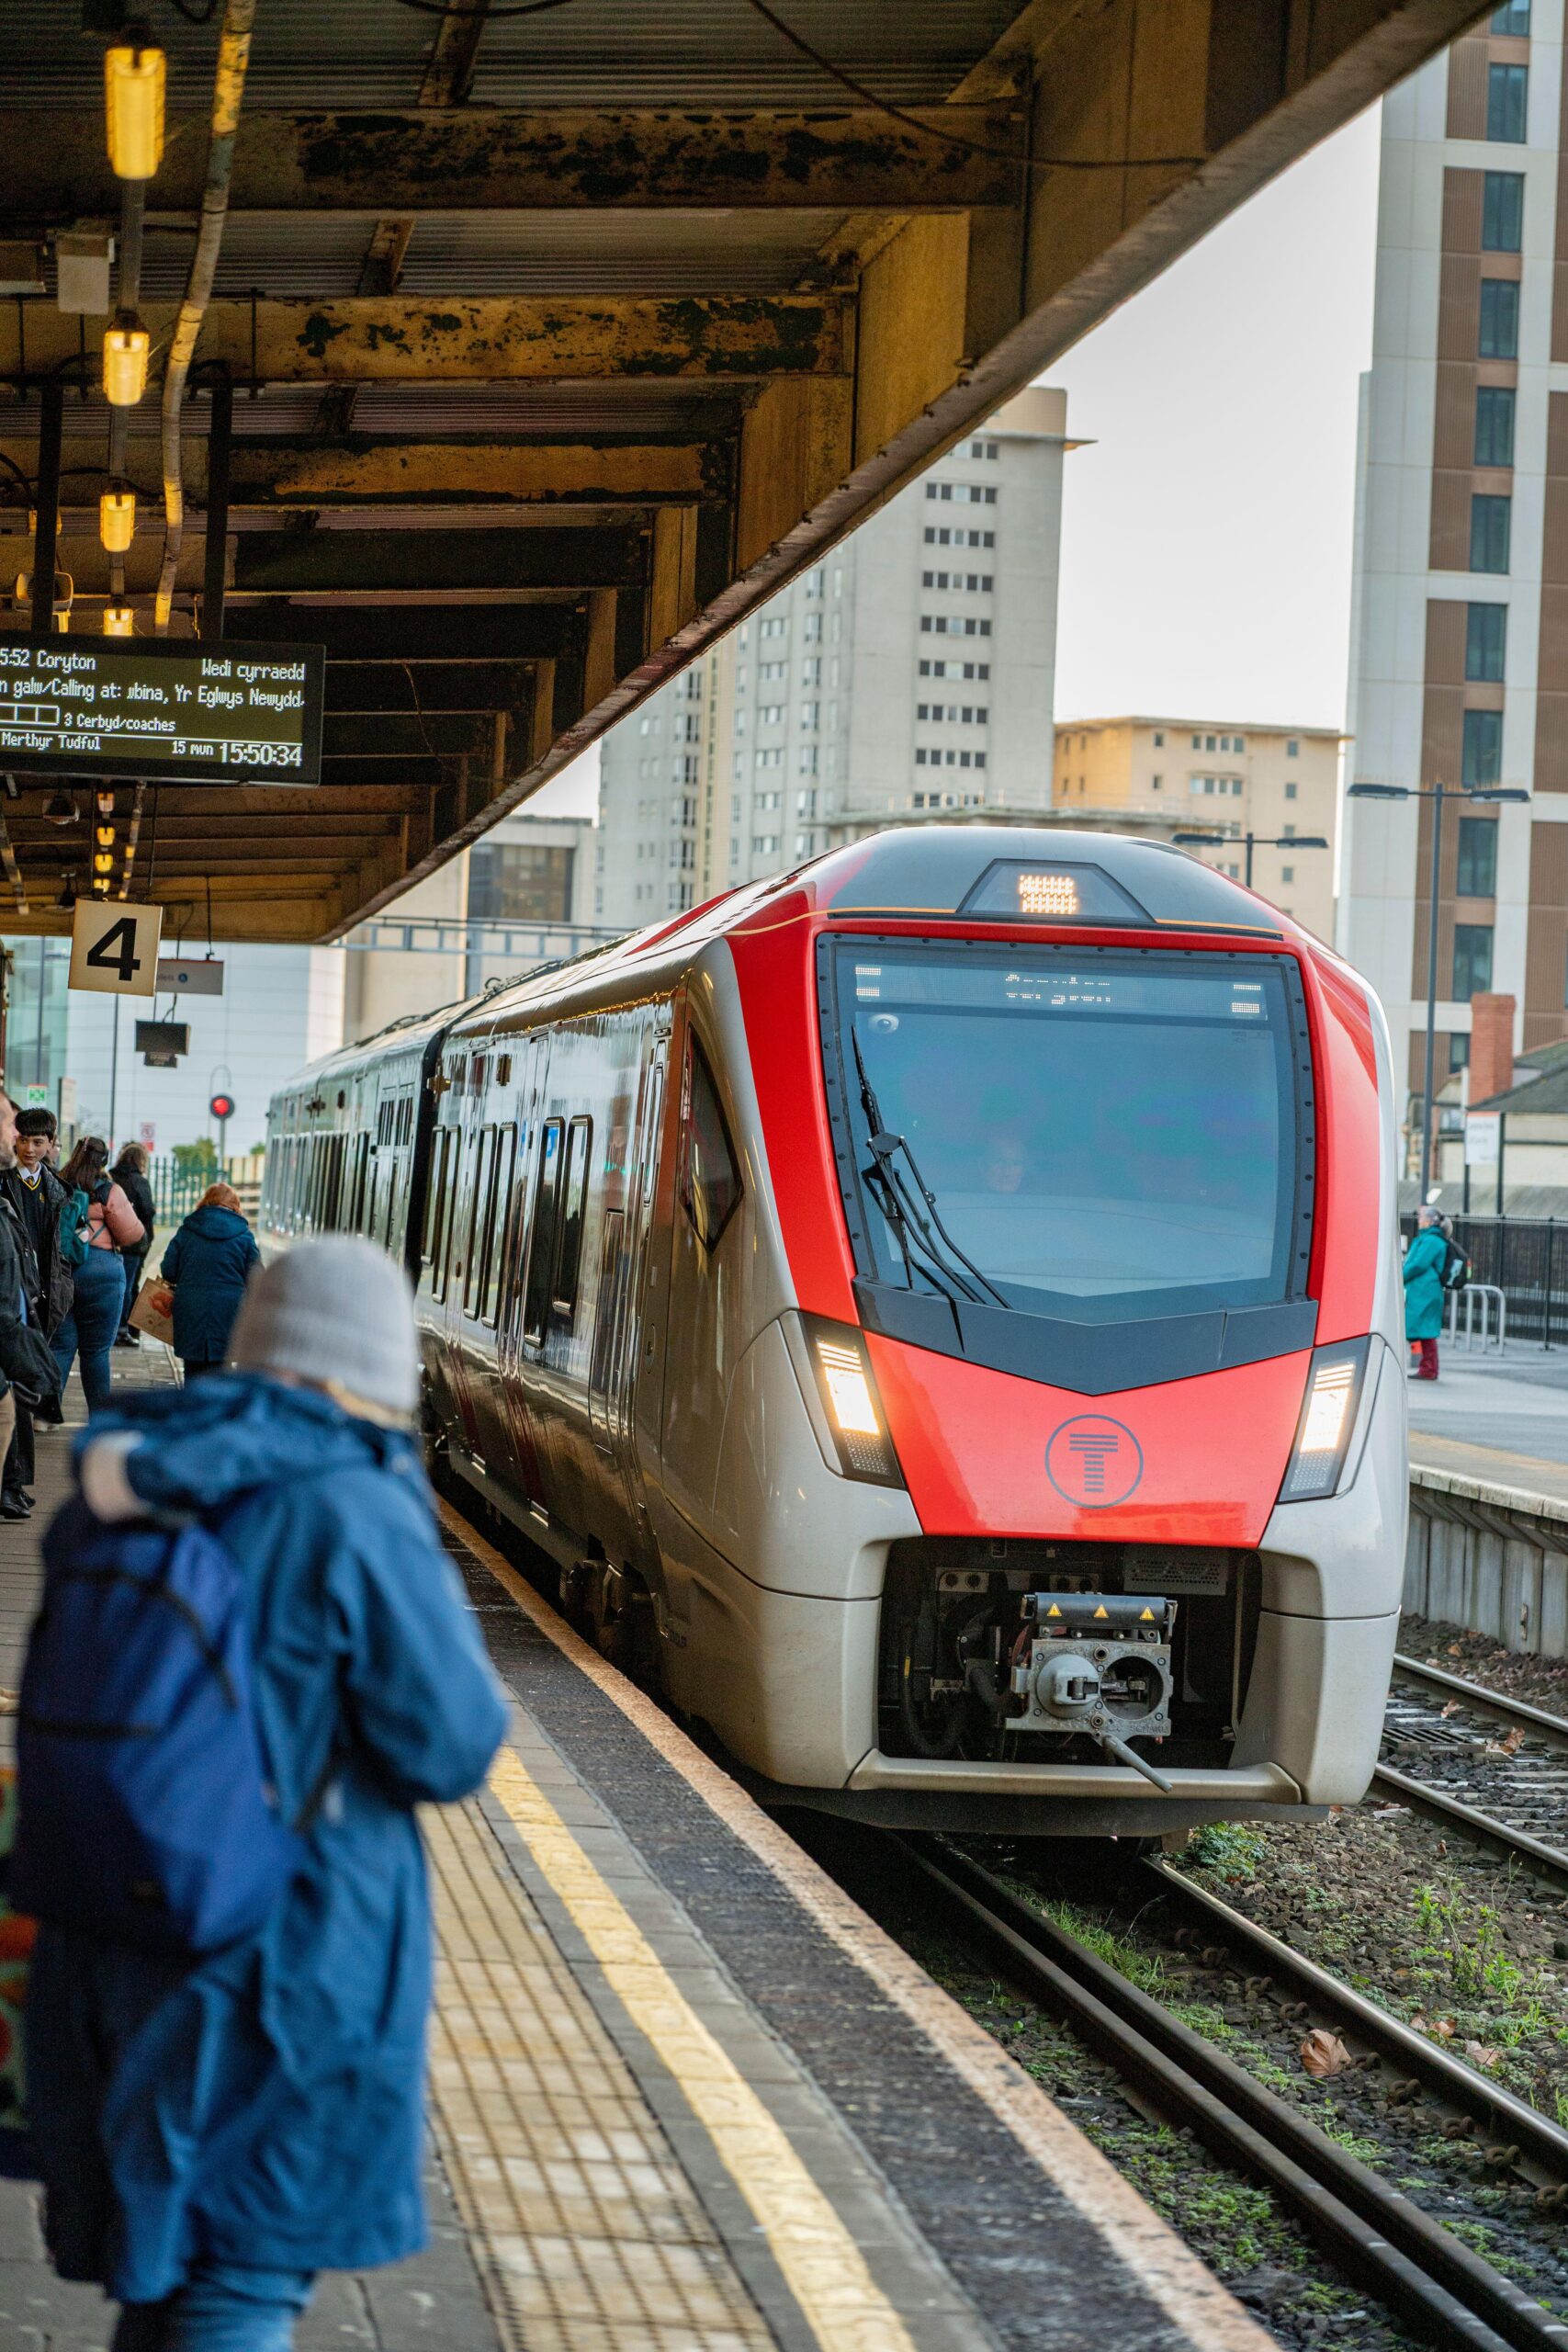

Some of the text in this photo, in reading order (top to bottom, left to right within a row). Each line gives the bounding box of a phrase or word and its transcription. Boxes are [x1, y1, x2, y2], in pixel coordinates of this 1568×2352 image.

[37, 650, 96, 674] Coryton
[202, 658, 306, 683] Wedi cyrraedd
[13, 677, 96, 702] galw/Calling
[101, 683, 122, 698] at:
[175, 684, 192, 702] Yr
[197, 685, 243, 709] Eglwys
[64, 712, 176, 733] 3 Cerbyd/coaches
[1, 732, 214, 756] Merthyr Tudful 15 mun
[219, 742, 302, 767] 15:50:34
[86, 917, 141, 981] 4
